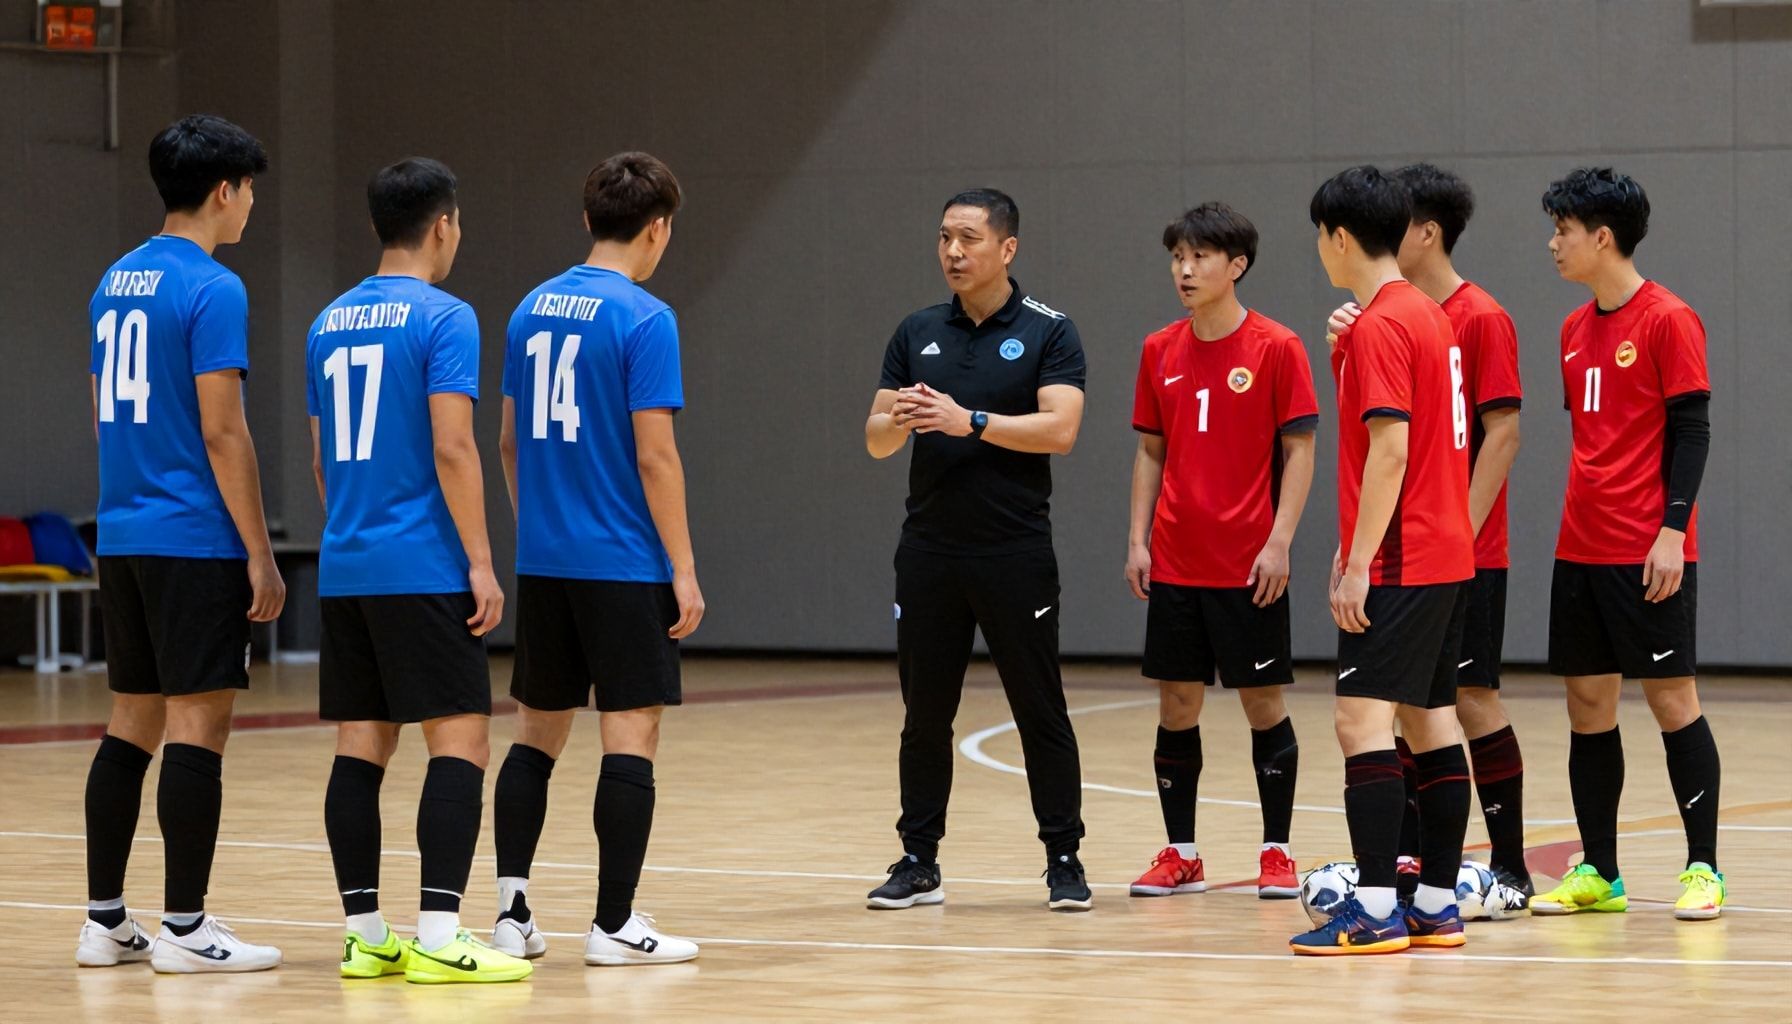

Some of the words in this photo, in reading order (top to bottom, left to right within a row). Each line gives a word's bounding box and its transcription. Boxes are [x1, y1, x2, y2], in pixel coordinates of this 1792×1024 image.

[324, 344, 384, 462] 17
[527, 331, 582, 443] 14
[1196, 388, 1210, 432] 1
[1583, 367, 1602, 412] 11
